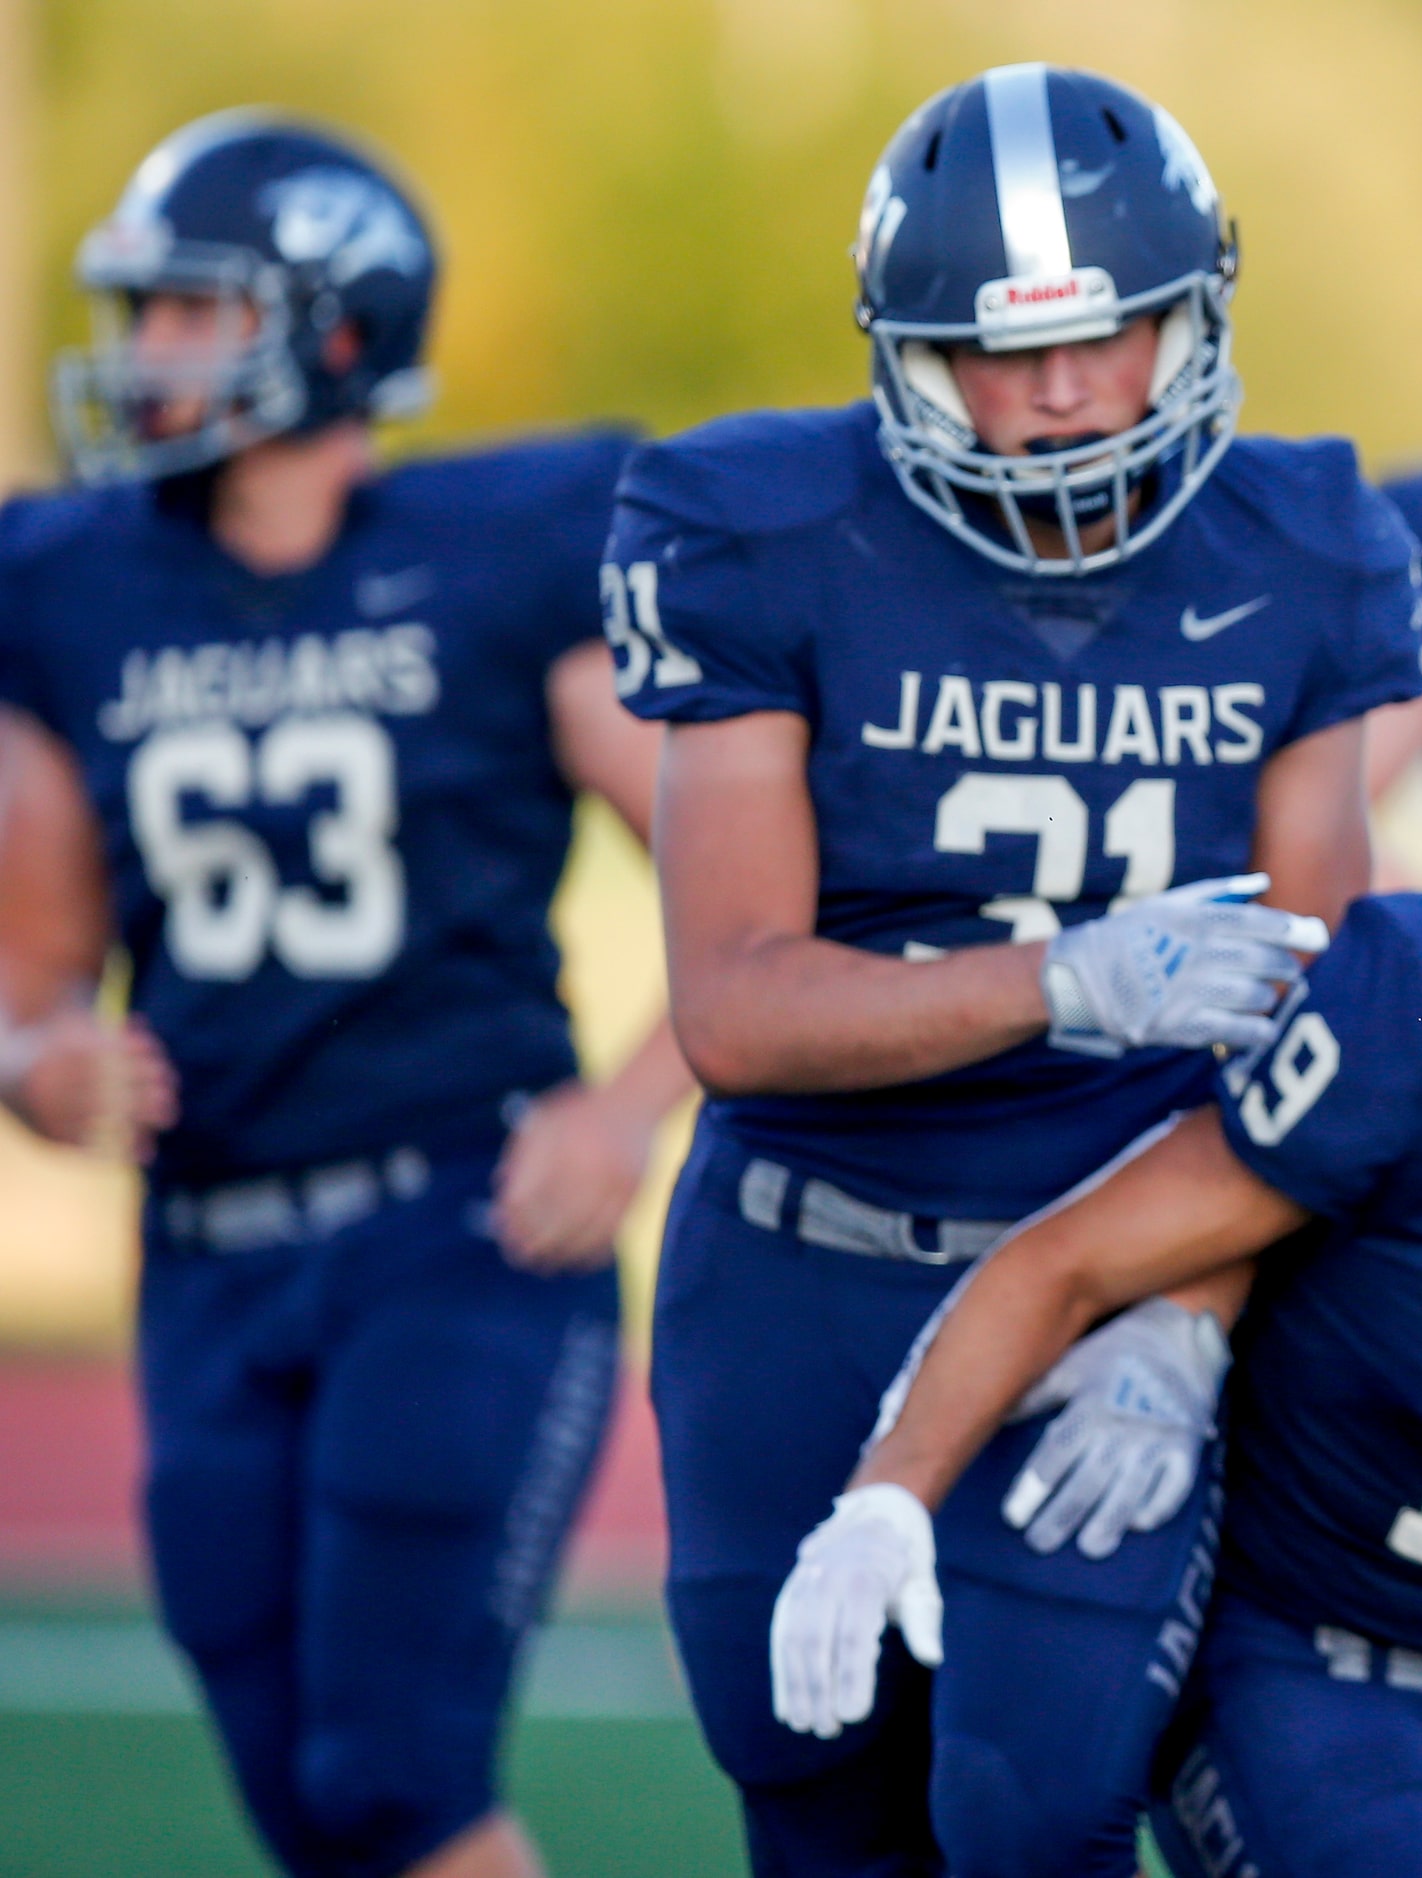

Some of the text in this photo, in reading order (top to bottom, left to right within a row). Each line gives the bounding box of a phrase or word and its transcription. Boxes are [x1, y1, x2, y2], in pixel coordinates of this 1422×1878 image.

[599, 560, 703, 699] 31
[861, 671, 1265, 765] JAGUARS
[126, 708, 405, 982] 63
